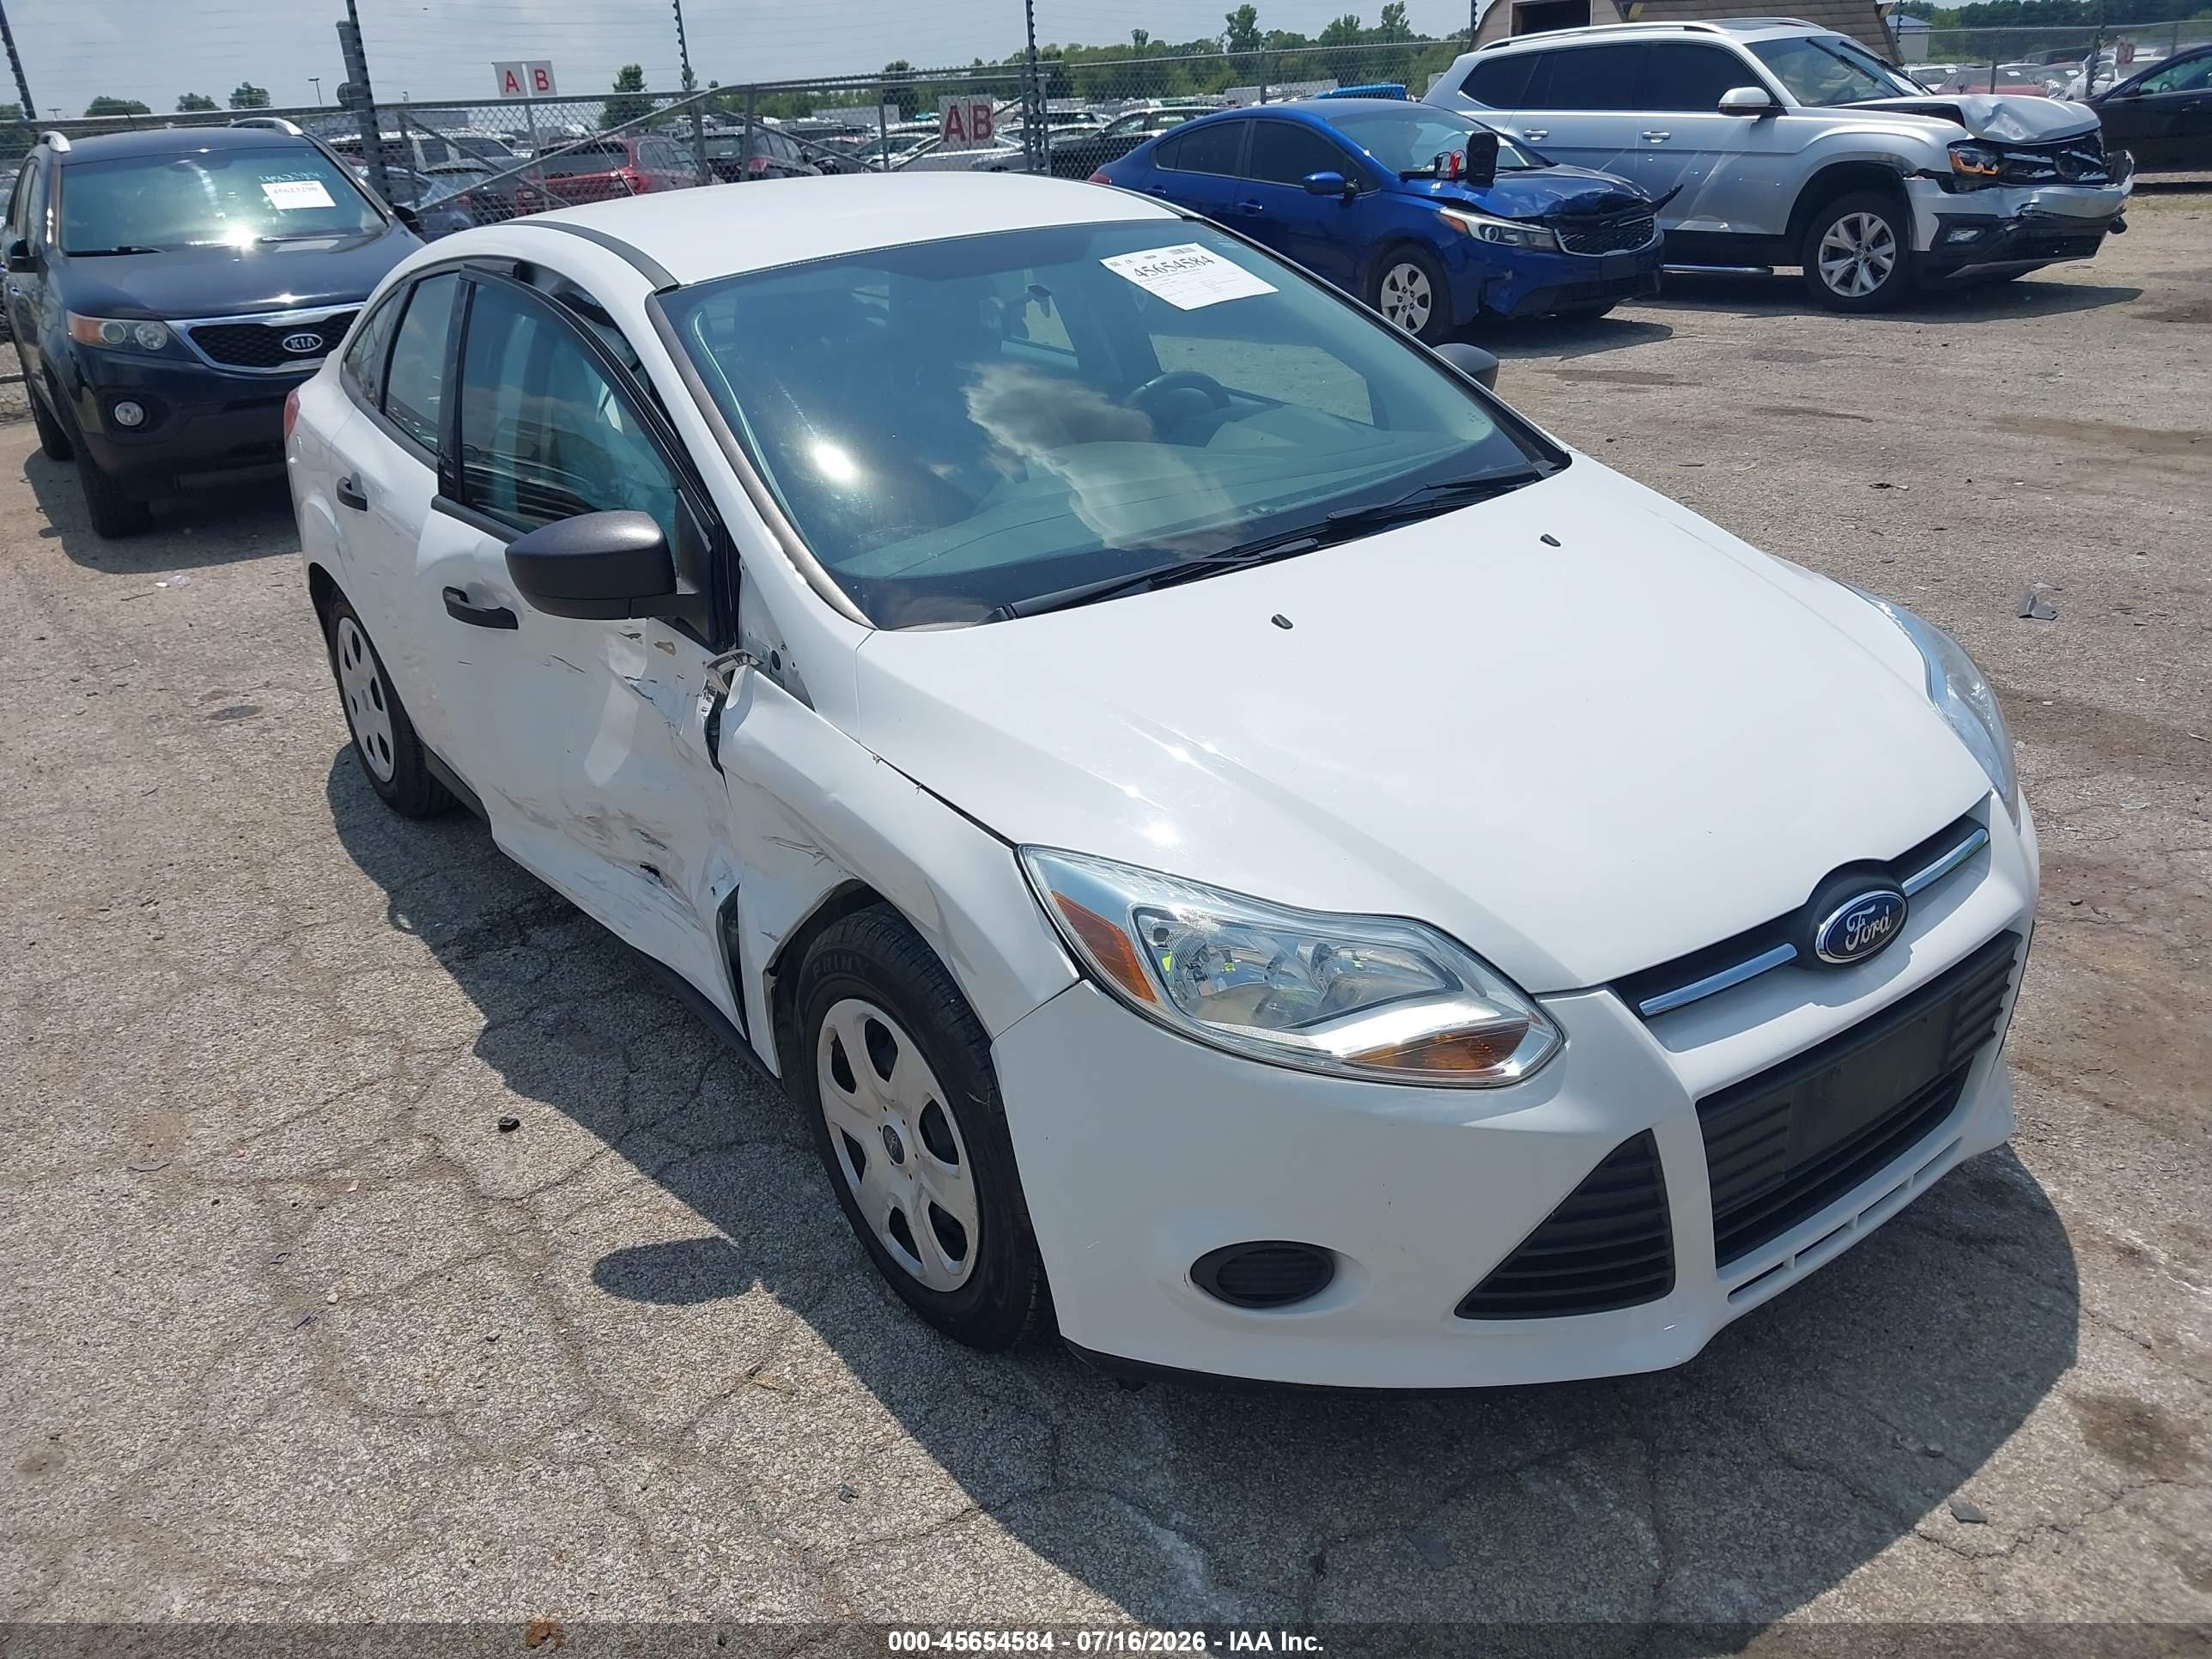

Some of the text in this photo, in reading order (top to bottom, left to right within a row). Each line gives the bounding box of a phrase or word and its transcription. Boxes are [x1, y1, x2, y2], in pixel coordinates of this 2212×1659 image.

[505, 69, 550, 93] A B
[944, 105, 992, 142] A B
[1133, 254, 1216, 278] 45654584
[290, 337, 317, 349] KIA
[1844, 903, 1893, 951] Ford
